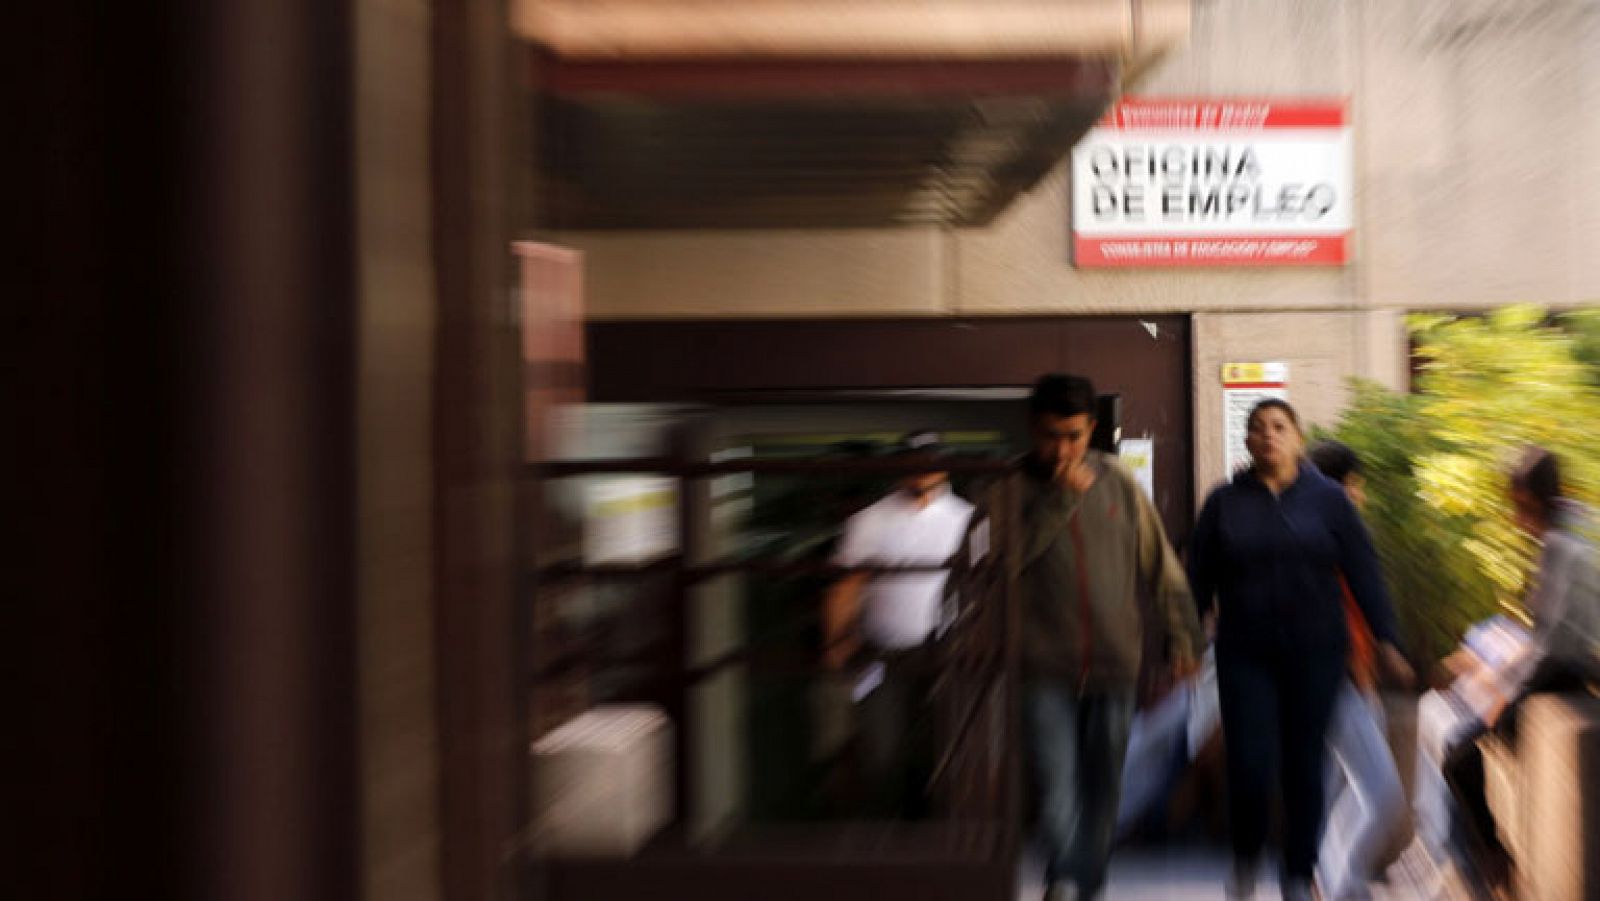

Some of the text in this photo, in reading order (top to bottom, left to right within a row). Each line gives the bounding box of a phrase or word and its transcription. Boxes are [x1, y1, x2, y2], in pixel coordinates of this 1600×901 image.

[1090, 144, 1262, 181] OFICINA
[1091, 181, 1338, 222] DE EMPLEO
